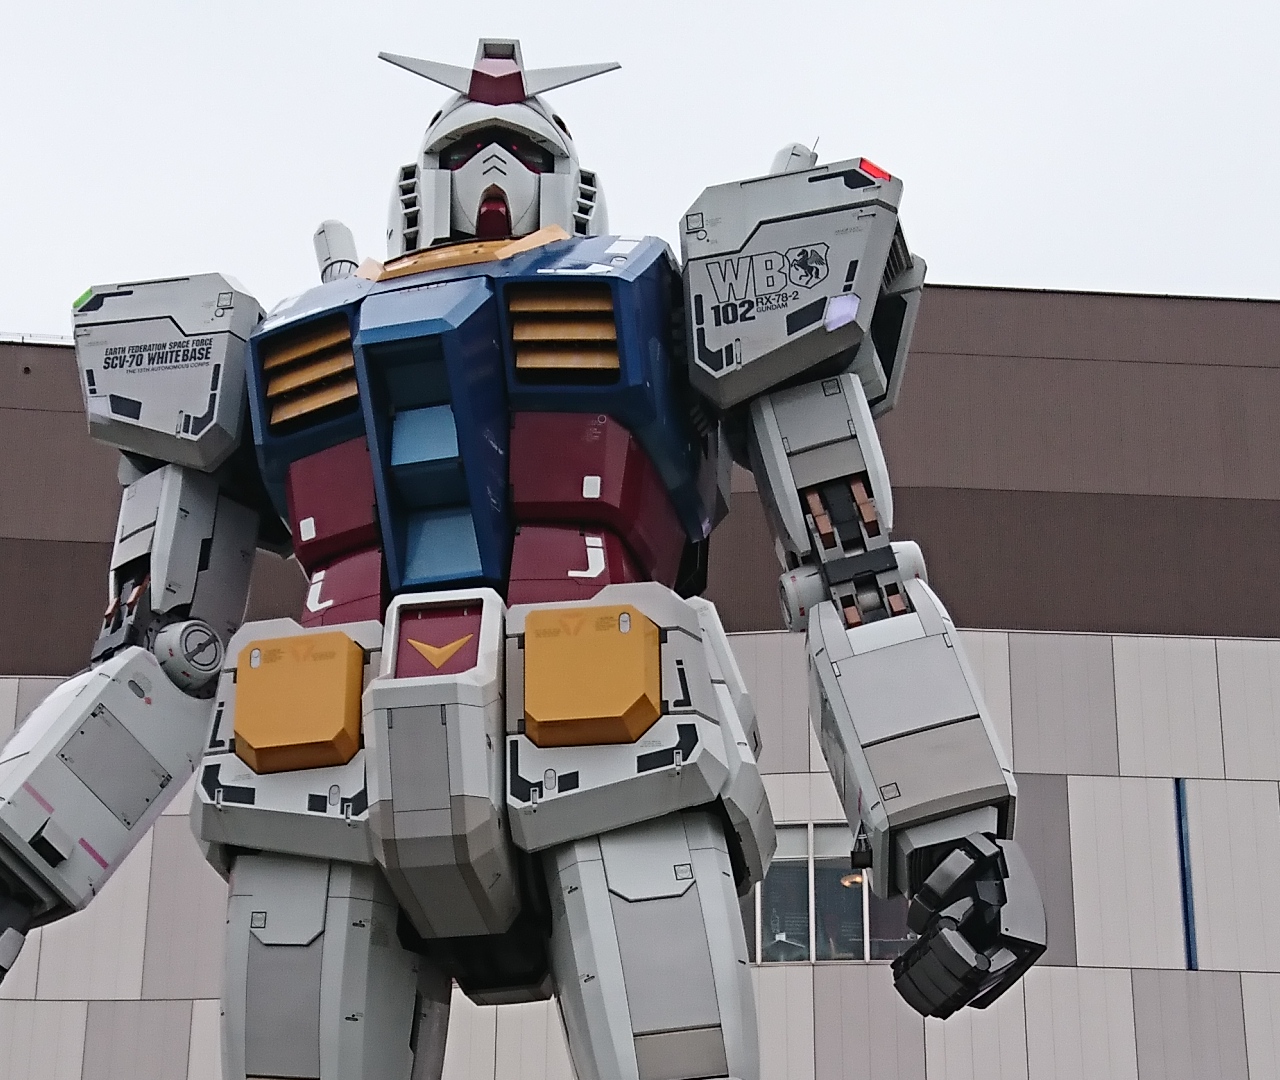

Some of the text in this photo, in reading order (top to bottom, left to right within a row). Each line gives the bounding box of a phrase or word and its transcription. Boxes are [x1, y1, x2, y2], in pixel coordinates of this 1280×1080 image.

[756, 290, 800, 307] RX-78-2
[710, 299, 756, 327] 102
[756, 302, 789, 313] GUNDAM
[105, 337, 214, 356] EARTH FEDERATION SPACE FORCE
[103, 353, 144, 370] SCV-70
